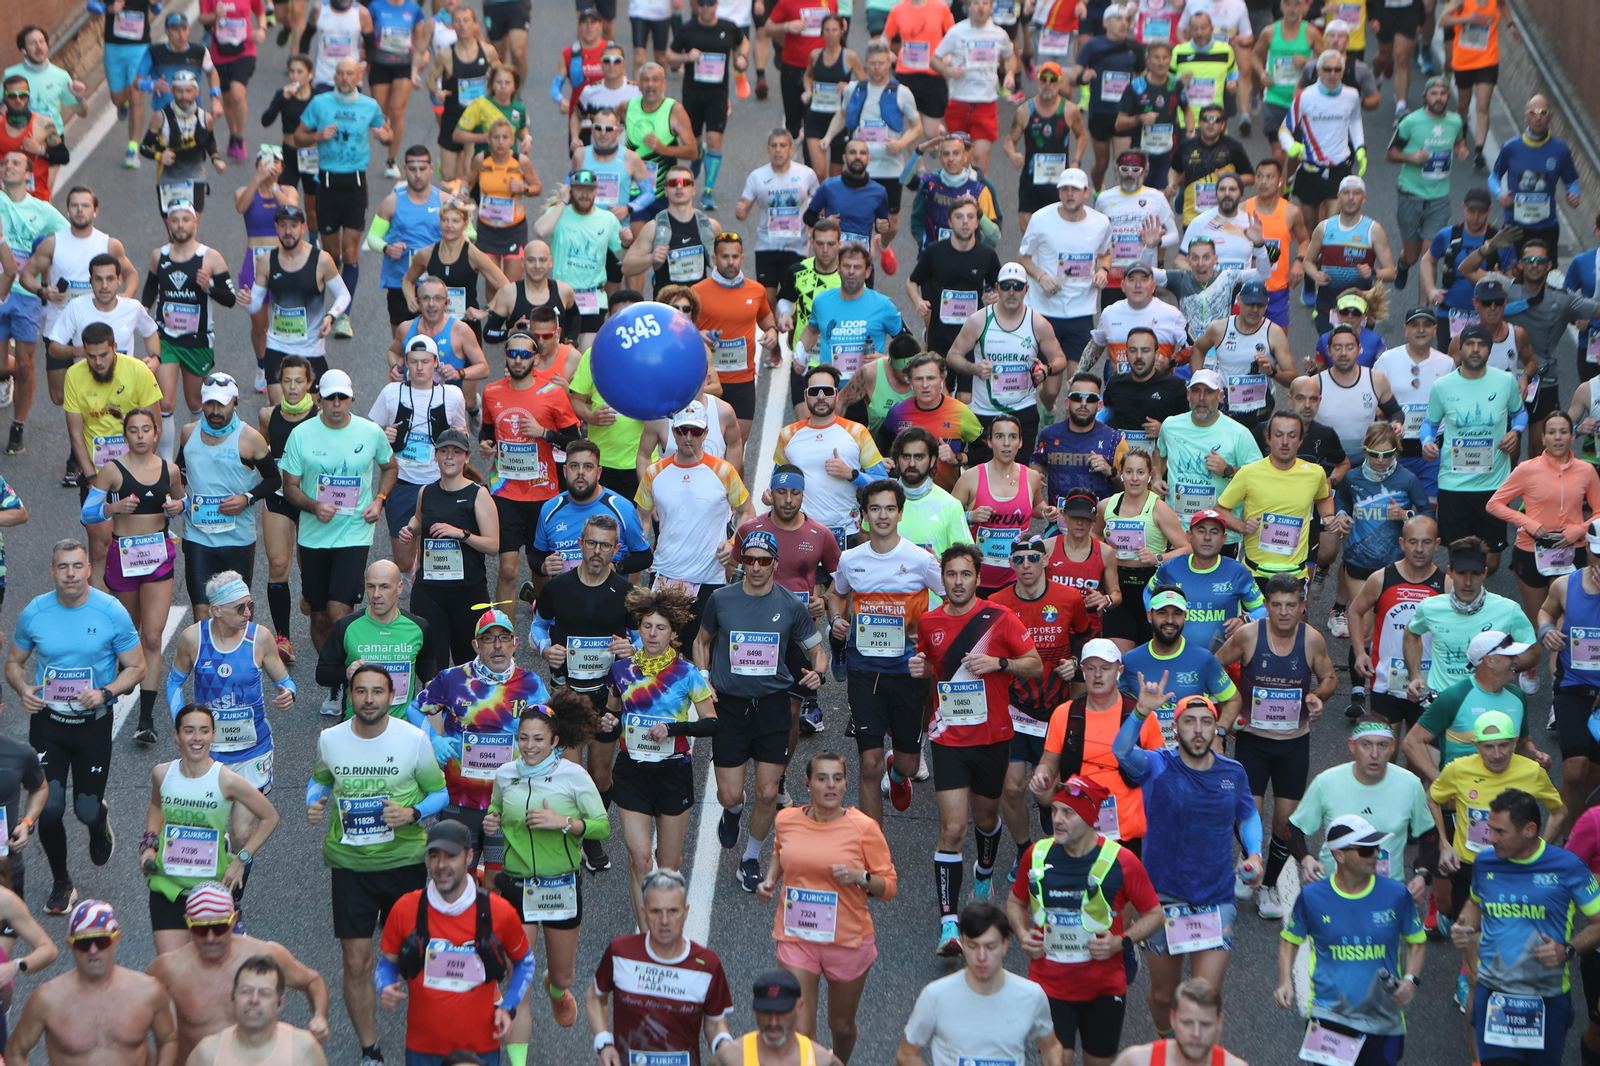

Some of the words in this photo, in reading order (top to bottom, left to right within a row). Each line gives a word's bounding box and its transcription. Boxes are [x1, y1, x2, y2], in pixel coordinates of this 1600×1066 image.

[768, 187, 798, 196] MADRID
[681, 249, 701, 258] ZURICH
[176, 305, 196, 313] ZURICH
[281, 309, 302, 317] ZURICH
[840, 319, 867, 329] LOOP
[615, 313, 662, 349] 3:45
[832, 327, 867, 337] GROEP
[722, 340, 743, 349] ZURICH
[987, 353, 1018, 363] TOGHER
[1005, 365, 1026, 374] ZURICH
[1241, 377, 1262, 385] ZURICH
[509, 445, 533, 454] ZURICH
[214, 448, 239, 461] 25
[508, 457, 525, 465] 10451
[333, 477, 357, 487] ZURICH
[332, 491, 347, 500] 7909
[1187, 487, 1210, 495] ZURICH
[210, 517, 228, 526] CABEZA
[1117, 521, 1141, 530] ZURICH
[1277, 516, 1301, 527] ZURICH
[993, 531, 1016, 539] ZURICH
[1275, 529, 1289, 538] 8494
[134, 536, 160, 546] ZURICH
[435, 540, 457, 550] ZURICH
[1271, 537, 1291, 546] SAMUEL
[433, 555, 449, 563] 10891
[130, 560, 146, 569] PATRI
[433, 563, 451, 572] TAMARA
[860, 604, 907, 616] MARCHENA
[873, 619, 900, 630] ZURICH
[748, 635, 774, 645] ZURICH
[872, 632, 889, 642] 9241
[1033, 634, 1056, 643] EBRO
[357, 642, 414, 653] camaralia
[584, 639, 611, 648] ZURICH
[361, 653, 392, 661] RUNNING
[393, 653, 411, 661] TEAM
[583, 653, 599, 662] 9326
[746, 649, 763, 658] 8498
[578, 662, 604, 671] FRÉDÉRIC
[58, 671, 86, 679] ZURICH
[58, 685, 75, 693] 8019
[953, 683, 979, 692] ZURICH
[1270, 691, 1297, 701] ZURICH
[953, 699, 971, 707] 10450
[952, 708, 974, 716] MADERA
[1269, 705, 1285, 713] 7079
[49, 712, 65, 723] UNDER
[65, 716, 86, 725] ARMOUR
[222, 711, 249, 720] ZURICH
[221, 726, 242, 735] 10429
[481, 737, 508, 745] ZURICH
[636, 743, 662, 752] ADRIANO
[479, 751, 496, 760] 6944
[333, 766, 400, 777] C.D.RUNNING
[342, 777, 388, 790] sano
[353, 800, 384, 810] ZURICH
[164, 807, 206, 822] sano
[353, 816, 376, 825] 11826
[181, 830, 213, 840] ZURICH
[167, 856, 194, 865] CRISTINA
[541, 893, 562, 902] 11044
[801, 893, 830, 903] ZURICH
[537, 901, 565, 910] VIZCAÍNO
[800, 910, 817, 919] 7324
[1484, 901, 1547, 921] TUSSAM
[1328, 943, 1387, 961] TUSSAM
[638, 973, 665, 984] HALF
[637, 982, 686, 996] MARATHON
[650, 1055, 682, 1065] ZURICH
